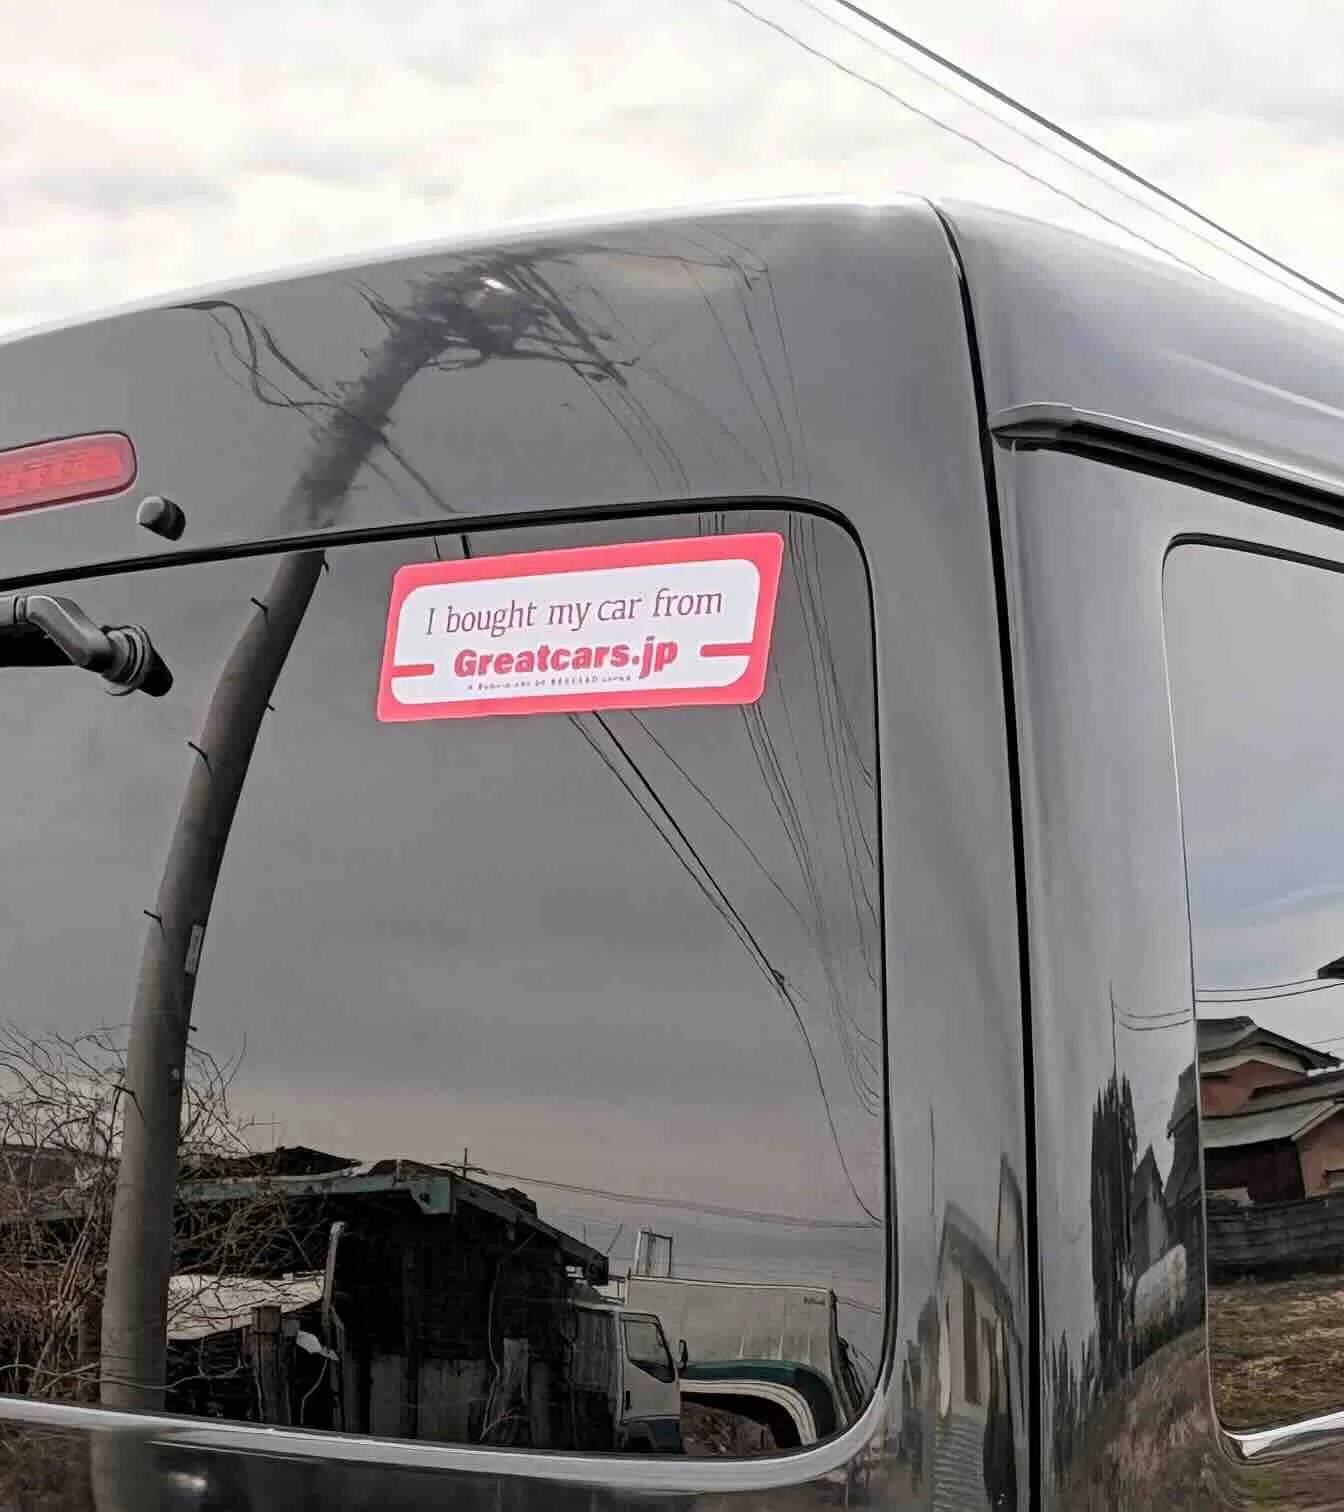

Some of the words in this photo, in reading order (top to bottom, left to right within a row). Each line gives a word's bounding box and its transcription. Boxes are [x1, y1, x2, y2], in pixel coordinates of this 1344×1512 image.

[425, 607, 435, 635] I
[445, 601, 536, 638] bought
[547, 602, 591, 631] my
[597, 597, 642, 621] car
[652, 587, 722, 619] from
[454, 635, 678, 680] Greatcars.jp
